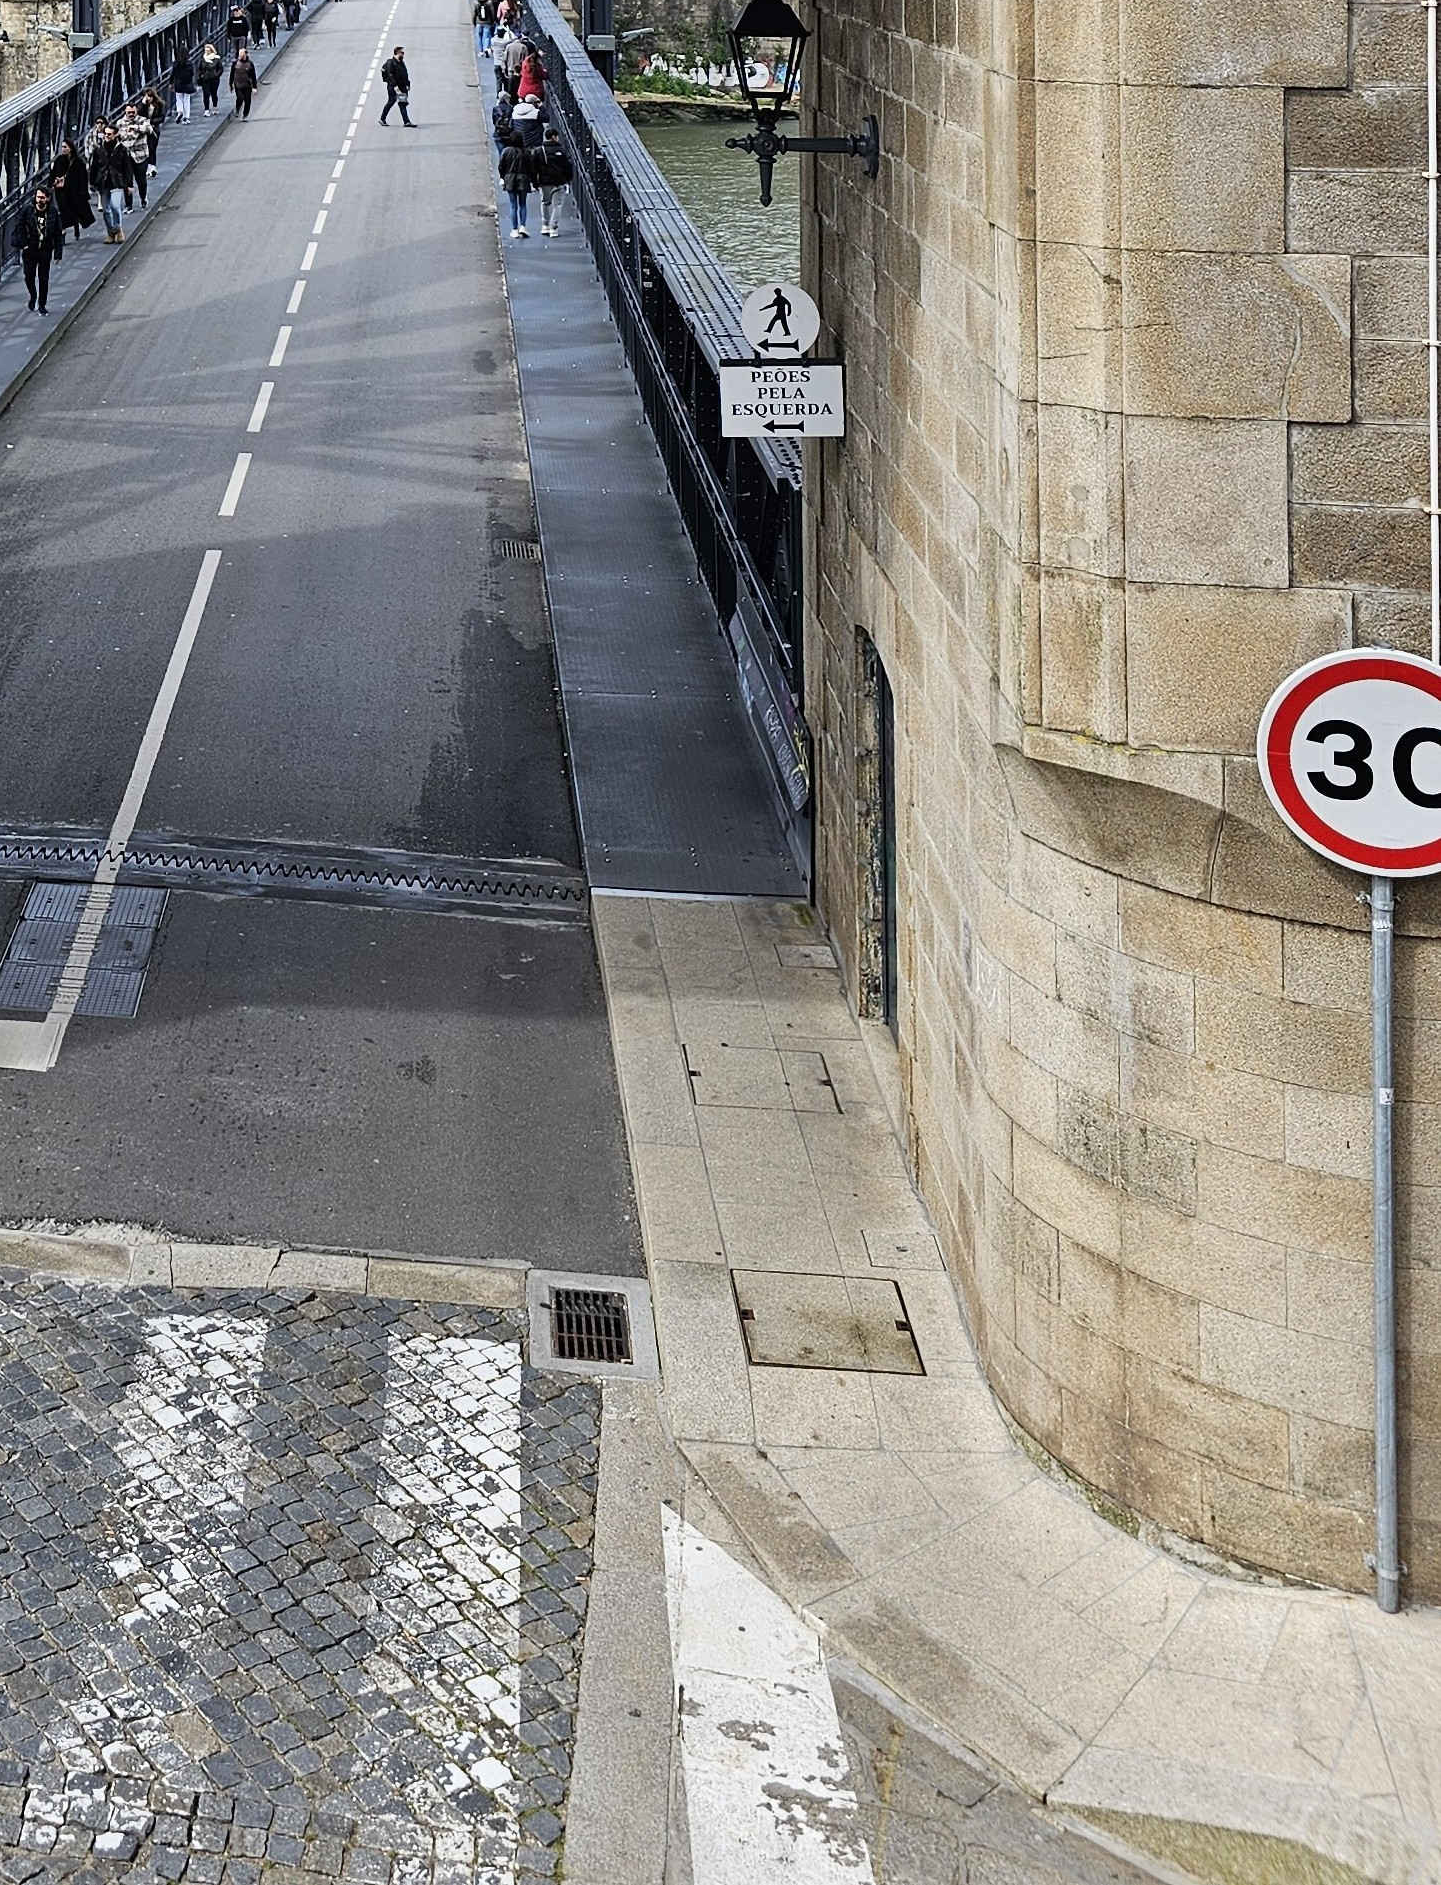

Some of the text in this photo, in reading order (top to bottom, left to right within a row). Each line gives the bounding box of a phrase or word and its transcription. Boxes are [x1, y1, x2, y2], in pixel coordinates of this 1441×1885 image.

[750, 368, 811, 383] PEÕES
[757, 387, 806, 400] PELA
[732, 403, 833, 418] ESQUERDA
